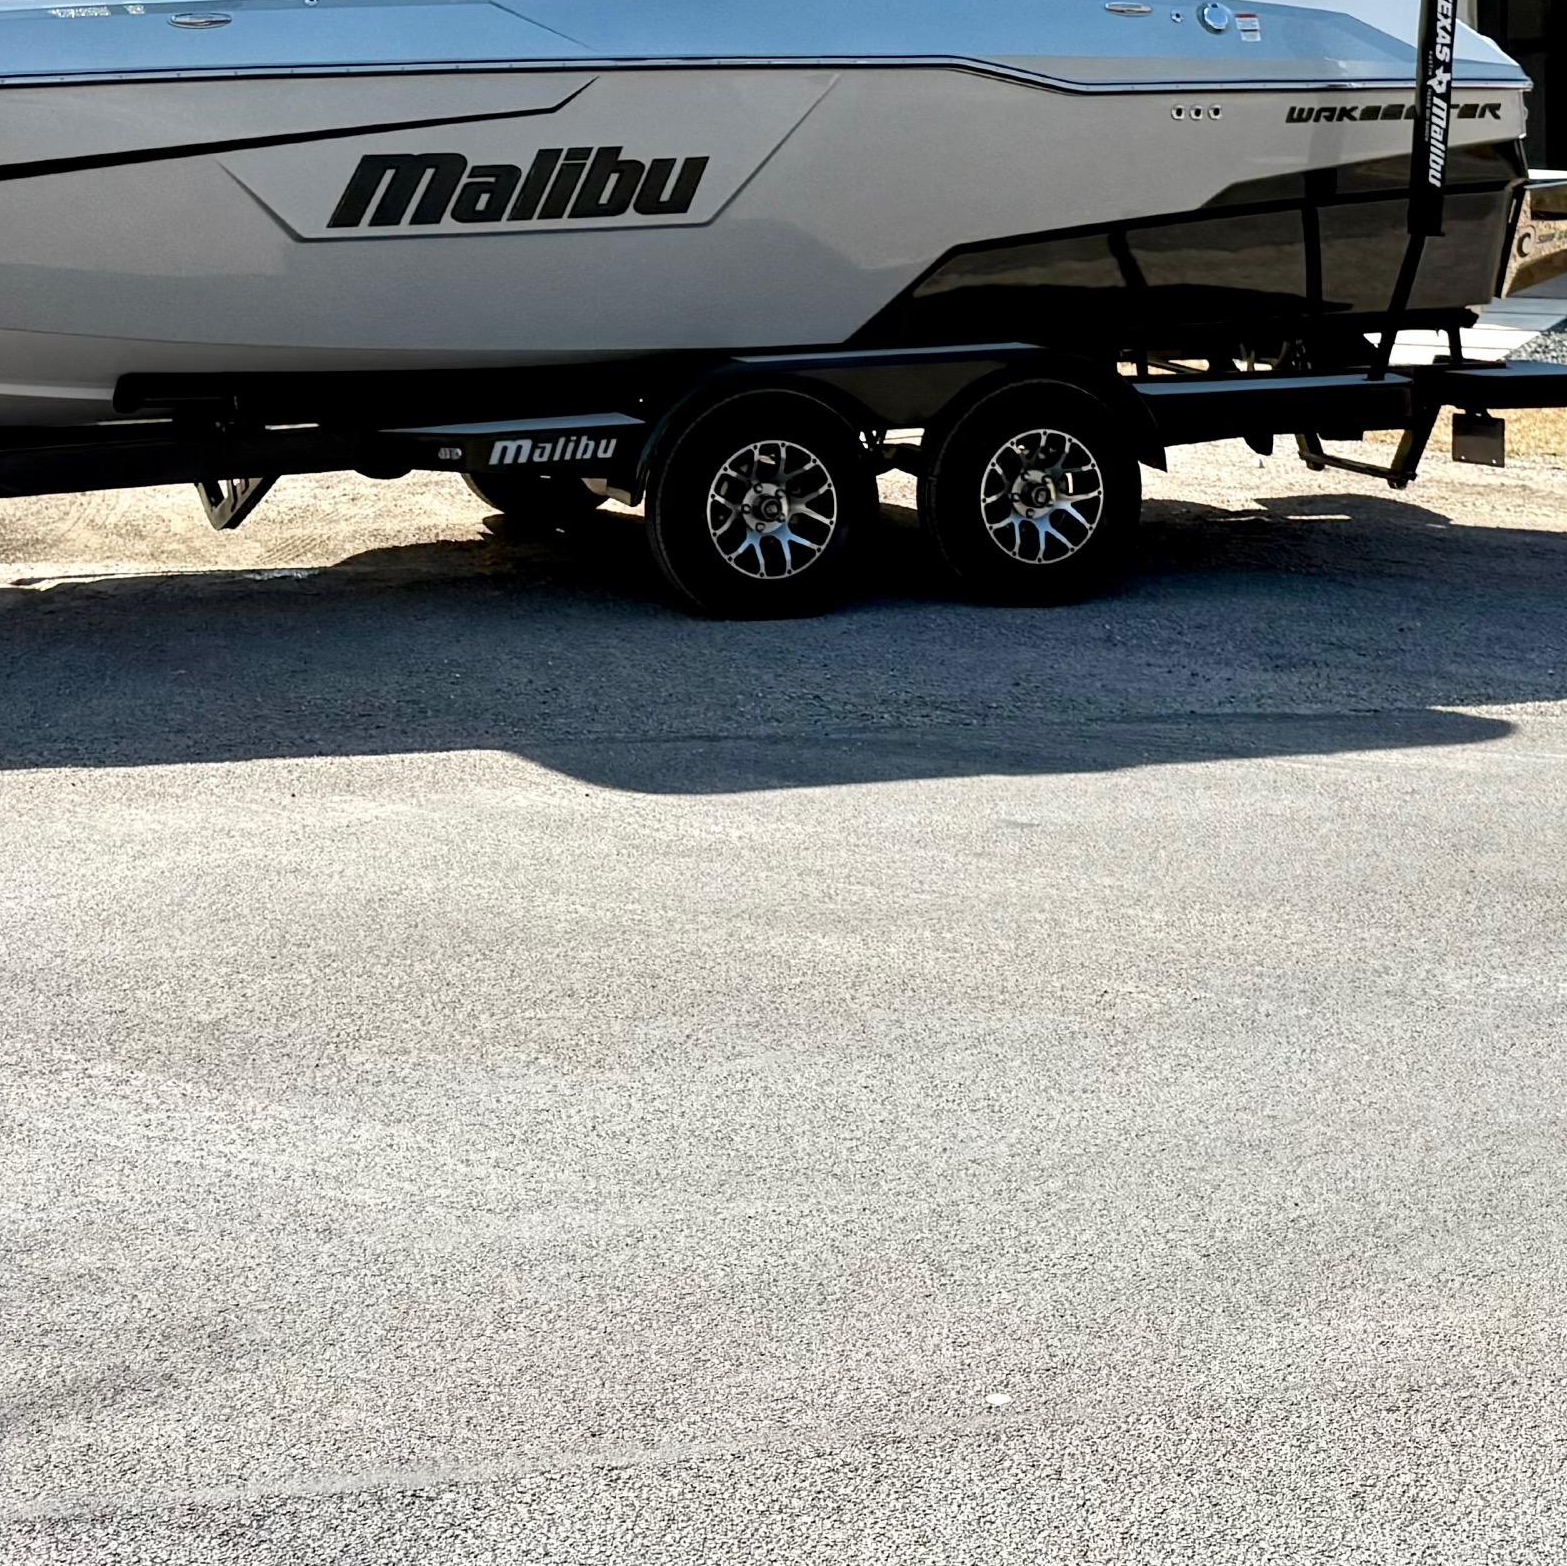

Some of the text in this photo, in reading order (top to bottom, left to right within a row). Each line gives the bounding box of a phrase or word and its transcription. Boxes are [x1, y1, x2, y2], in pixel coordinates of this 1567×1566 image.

[1428, 95, 1448, 188] Malibu
[326, 145, 710, 229] Malibu
[488, 435, 618, 466] Malibu
